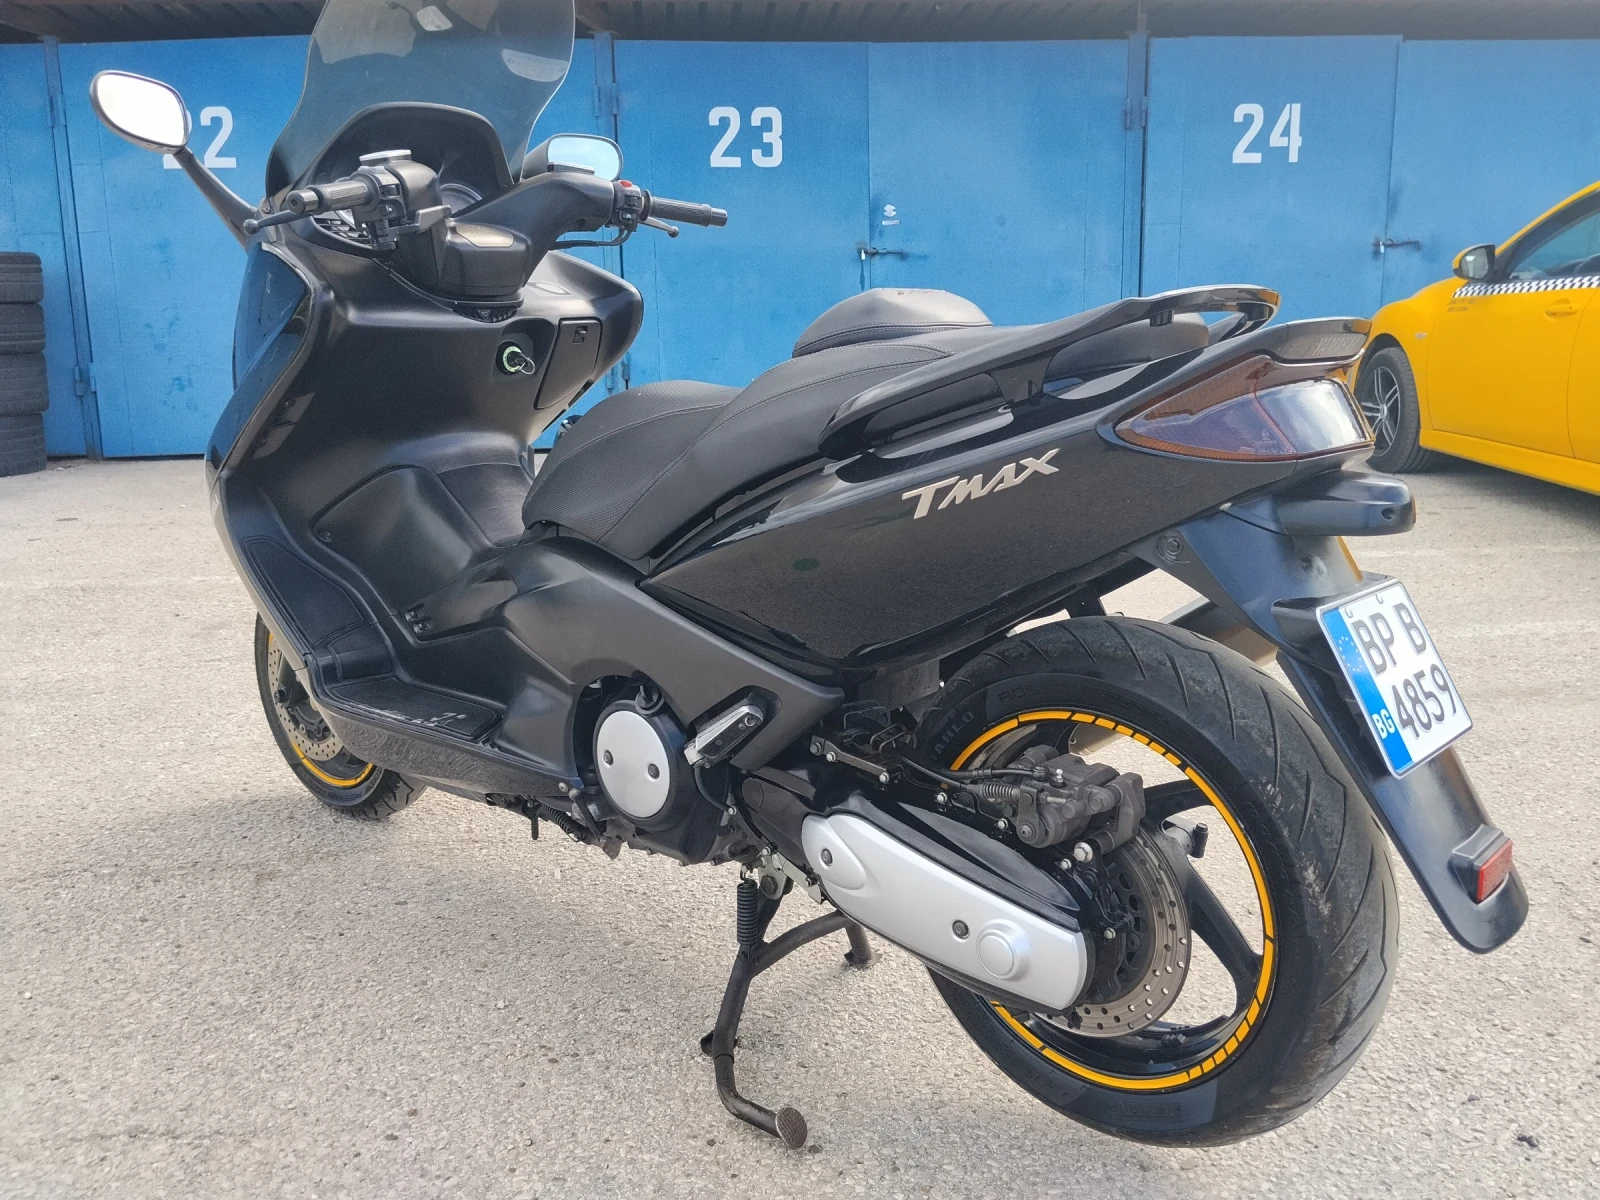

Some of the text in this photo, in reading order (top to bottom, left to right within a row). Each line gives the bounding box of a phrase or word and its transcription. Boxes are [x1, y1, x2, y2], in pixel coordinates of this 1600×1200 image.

[708, 106, 783, 168] 23
[1232, 103, 1303, 164] 24
[902, 448, 1061, 520] TMAX
[1351, 602, 1427, 675] BP B
[1372, 708, 1396, 739] BG
[1391, 663, 1457, 739] 4859
